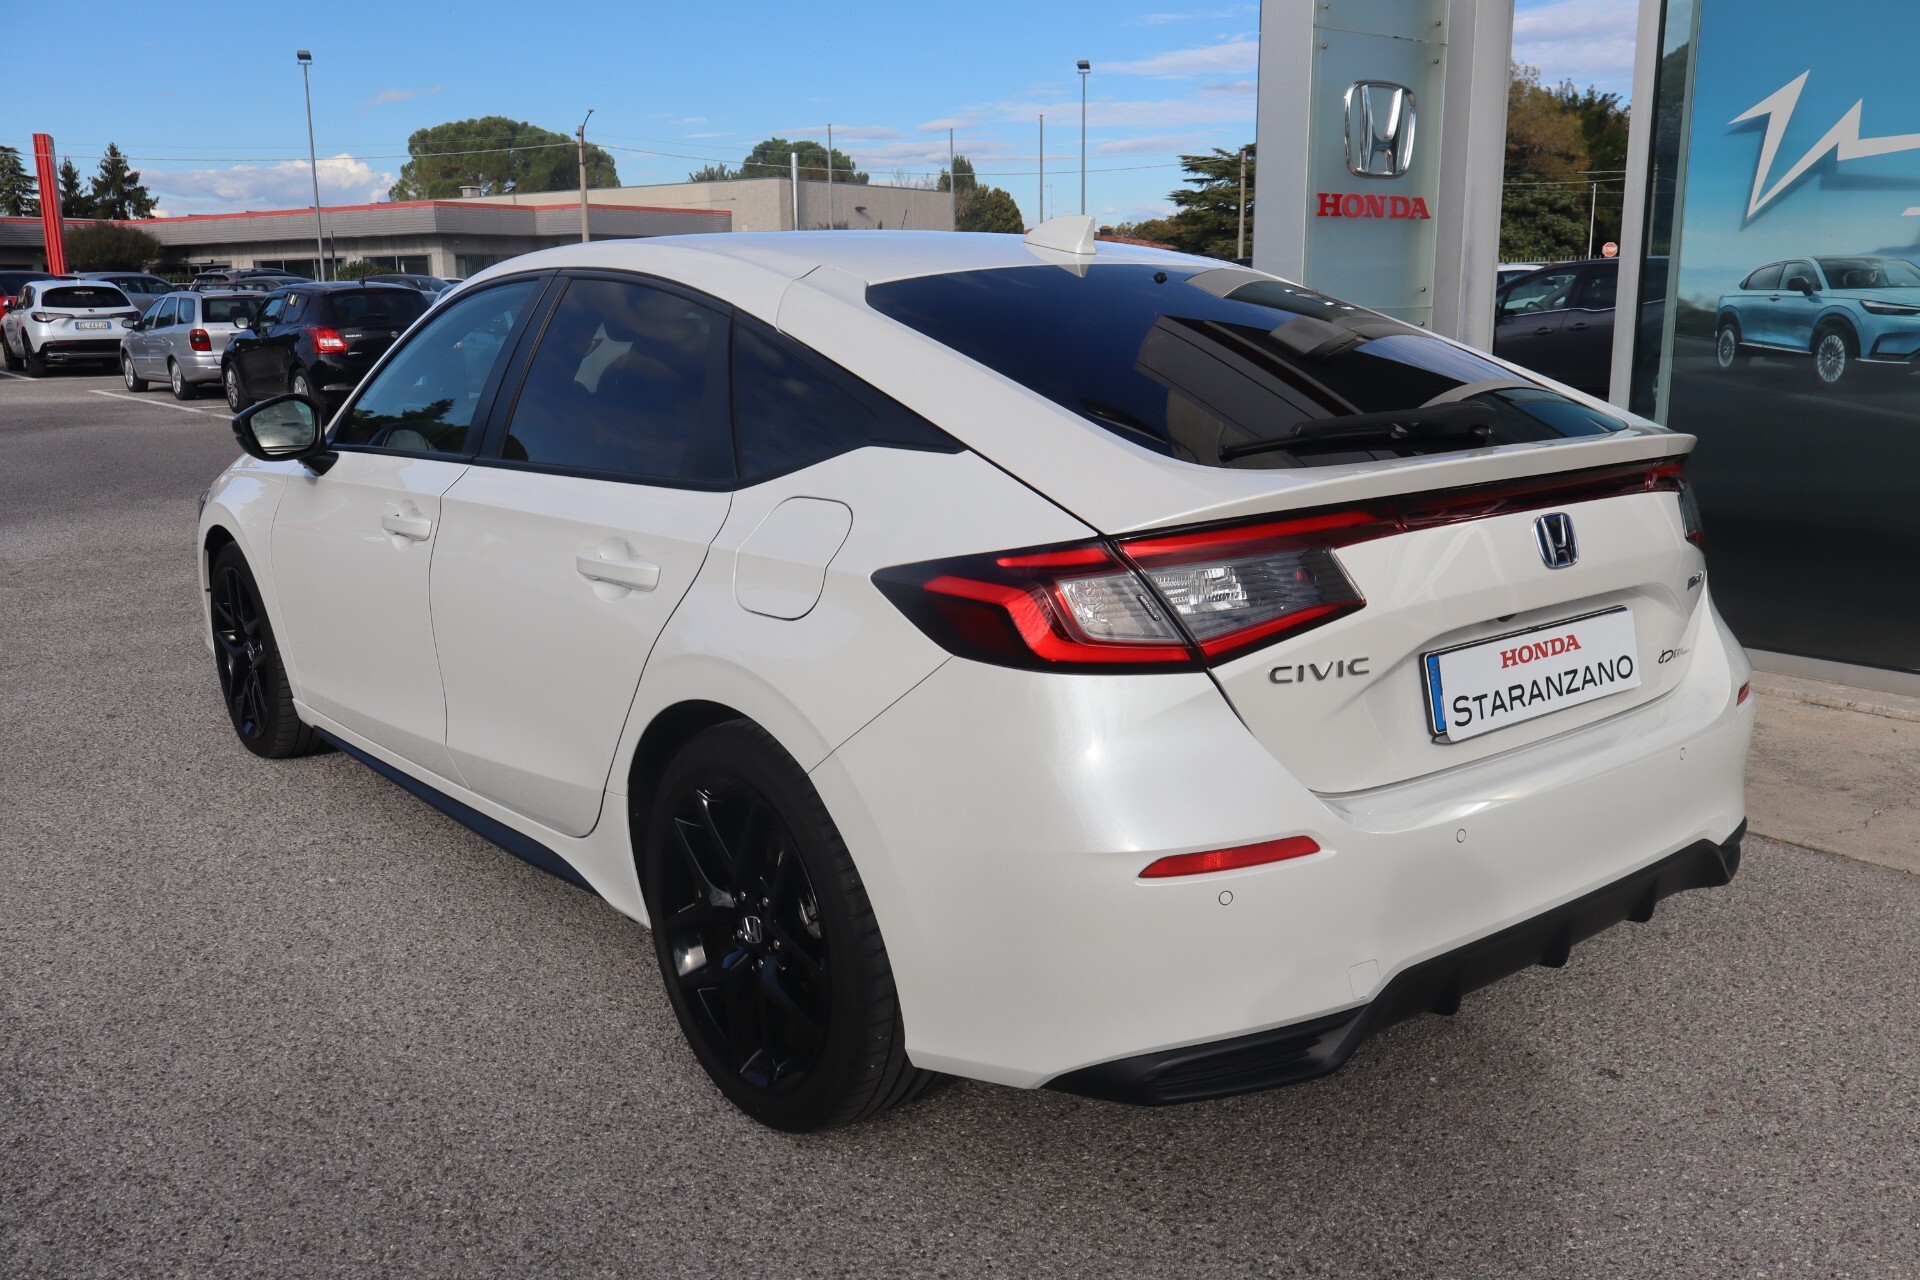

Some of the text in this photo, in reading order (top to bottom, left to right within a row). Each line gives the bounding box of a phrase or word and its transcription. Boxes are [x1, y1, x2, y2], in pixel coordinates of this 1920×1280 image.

[1316, 193, 1431, 220] HONDA
[1500, 634, 1581, 669] HONDA
[1269, 657, 1370, 684] CIVIC
[1452, 655, 1634, 727] STARANZANO
